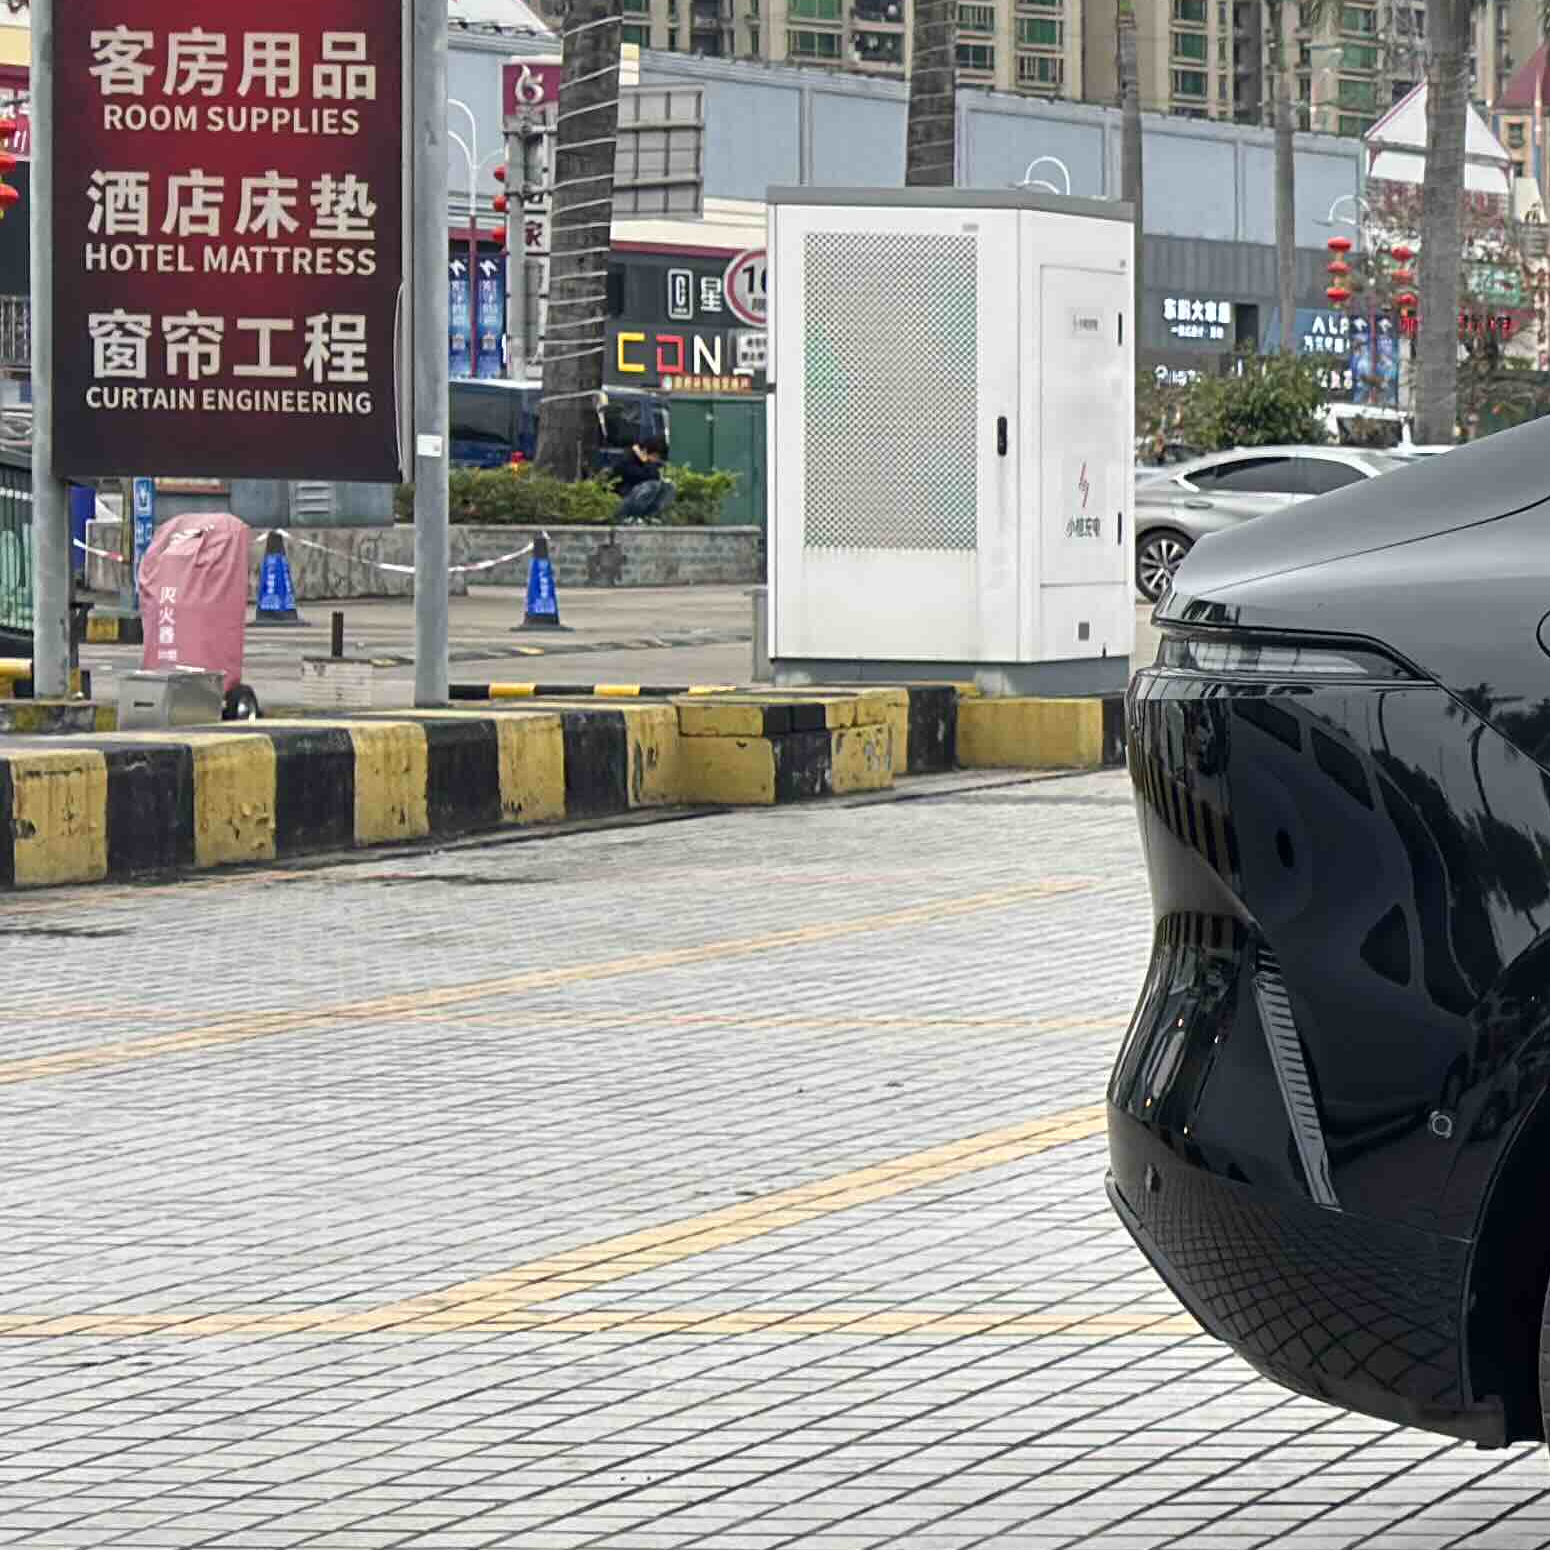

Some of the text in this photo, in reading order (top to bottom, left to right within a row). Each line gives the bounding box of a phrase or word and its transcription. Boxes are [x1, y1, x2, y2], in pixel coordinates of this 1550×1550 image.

[88, 24, 377, 101] 客房用品
[103, 104, 361, 135] ROOM SUPPLIES
[86, 168, 377, 241] 酒店床垫
[85, 243, 377, 276] HOTEL MATTRESS
[87, 307, 369, 384] 窗帘工程
[85, 386, 372, 415] CURTAIN ENGINEERING
